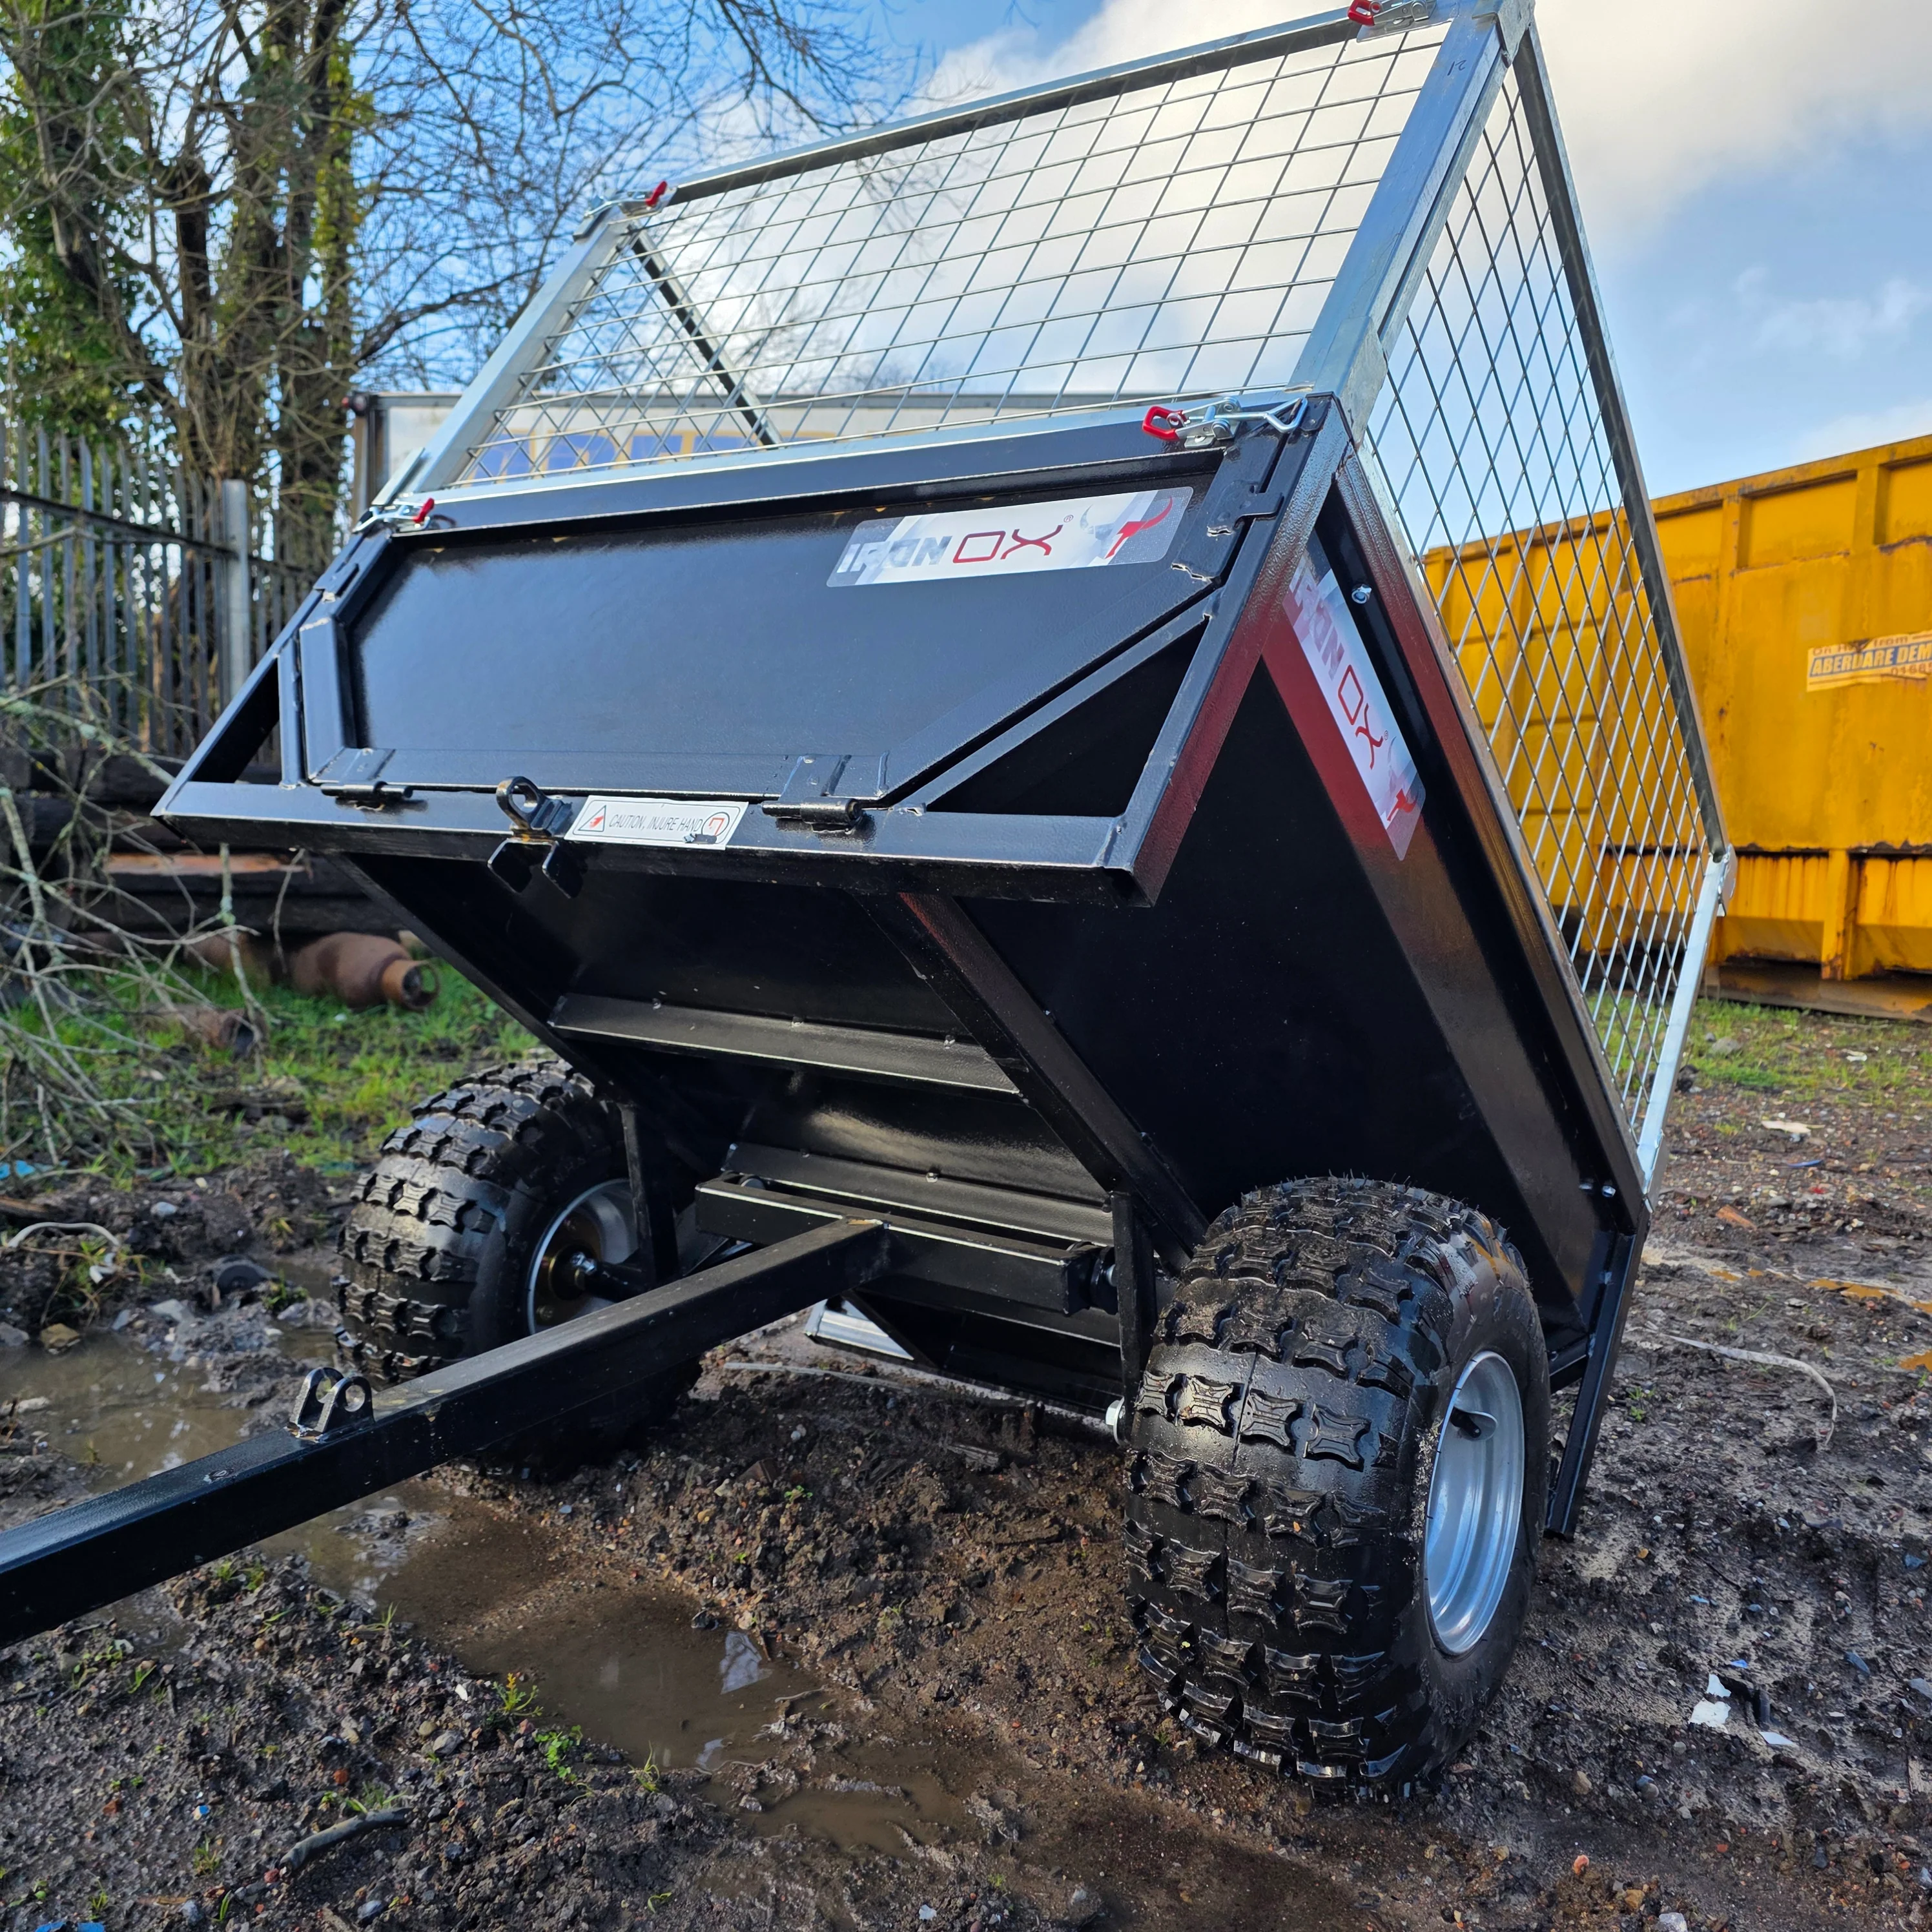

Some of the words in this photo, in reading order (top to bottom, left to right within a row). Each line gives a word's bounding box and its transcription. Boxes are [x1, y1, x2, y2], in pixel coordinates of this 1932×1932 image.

[609, 814, 646, 831] CAUTION,
[646, 816, 680, 831] INJURE
[676, 818, 703, 832] HAND
